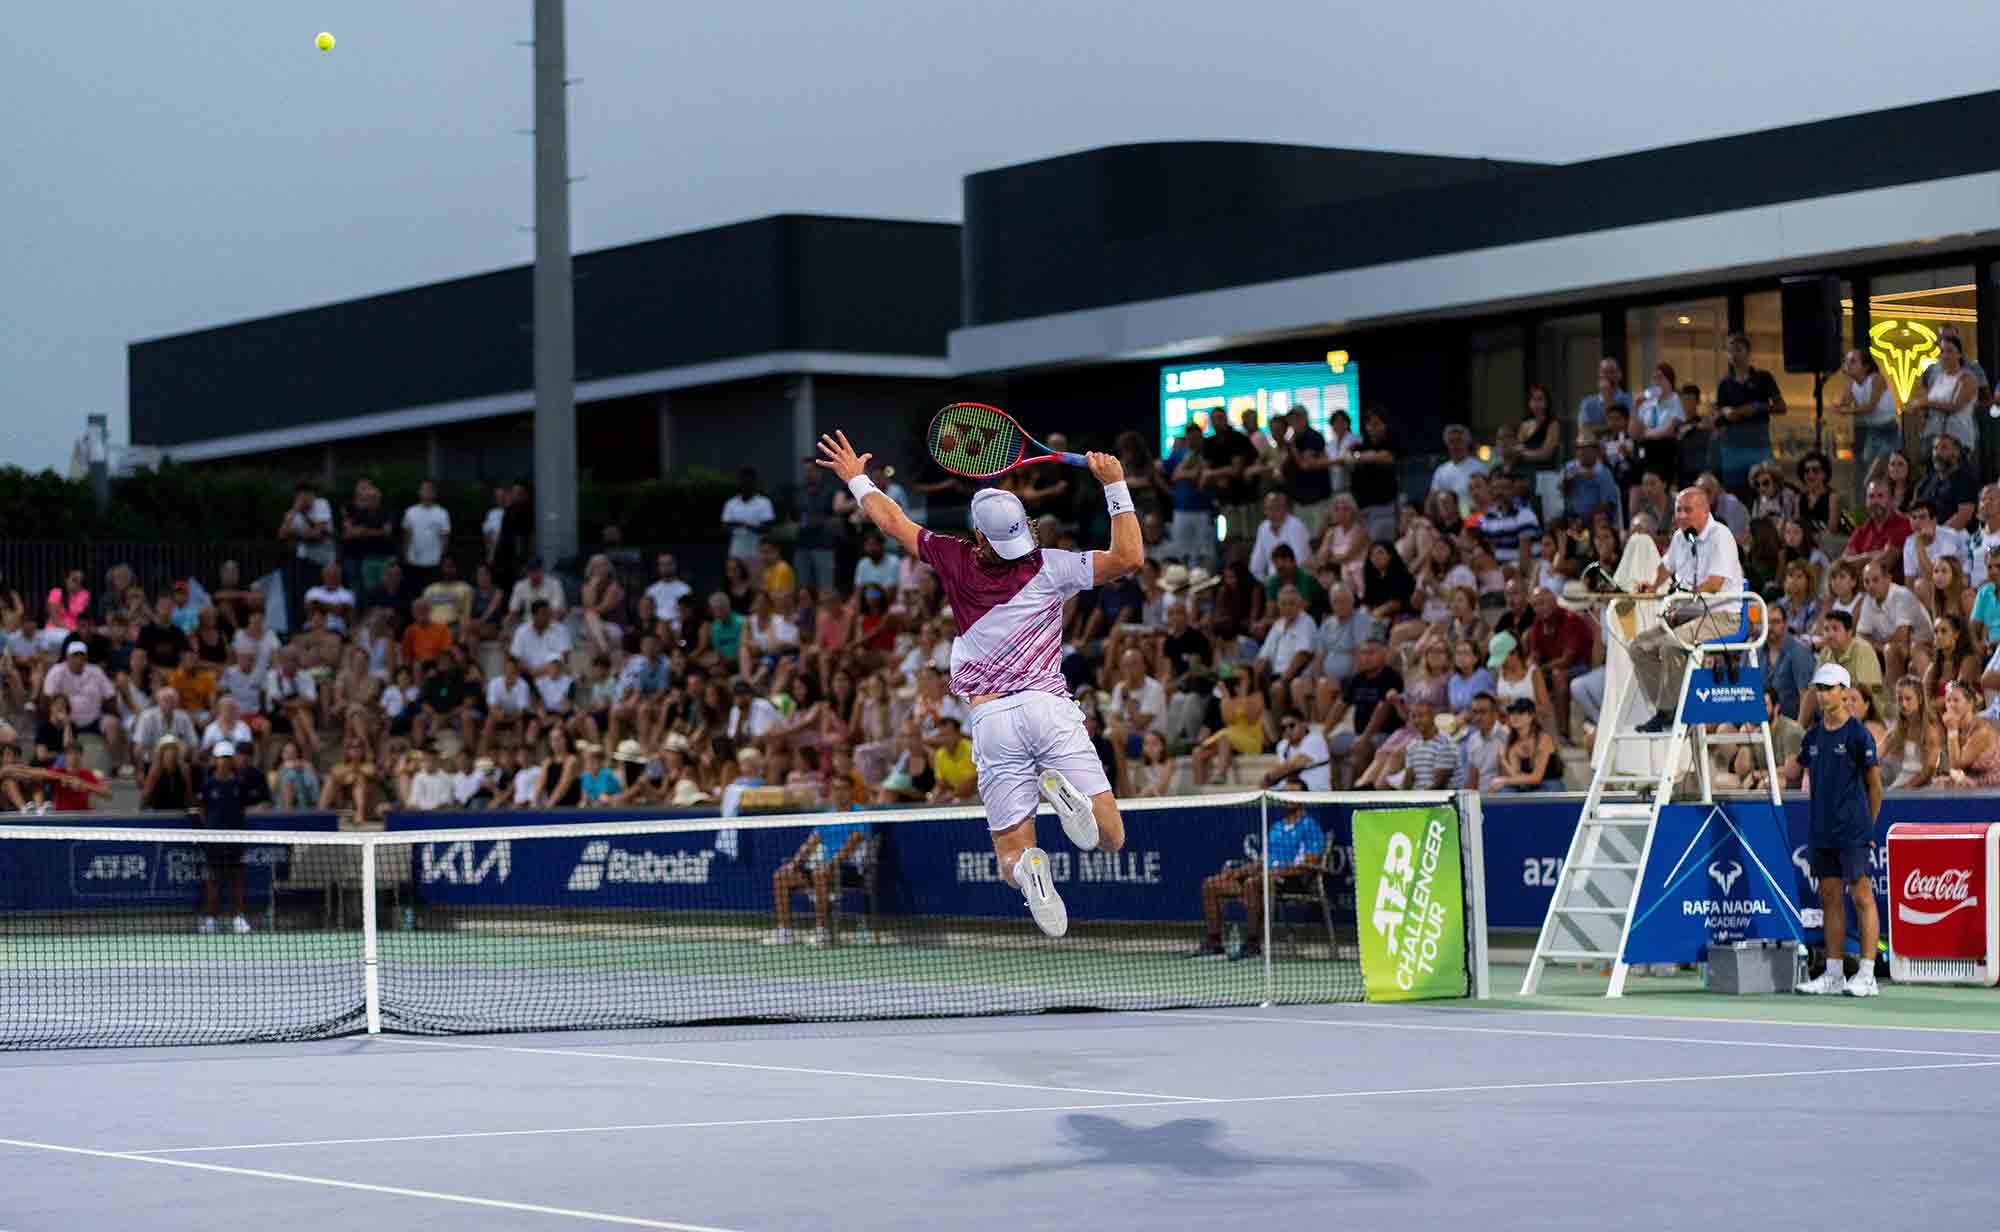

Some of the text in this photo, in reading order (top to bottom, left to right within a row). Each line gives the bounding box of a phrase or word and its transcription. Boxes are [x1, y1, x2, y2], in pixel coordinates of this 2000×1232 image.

[86, 854, 147, 881] ATP
[606, 848, 716, 885] Babolat
[957, 851, 1161, 884] RICD MILLE
[1373, 832, 1415, 957] ATP
[1903, 867, 1972, 900] Coca-Cola
[1396, 820, 1445, 991] CHALLENGER
[1683, 900, 1772, 915] RAFA NADAL
[1416, 902, 1447, 975] TOUR
[1704, 916, 1752, 929] ACADEMY
